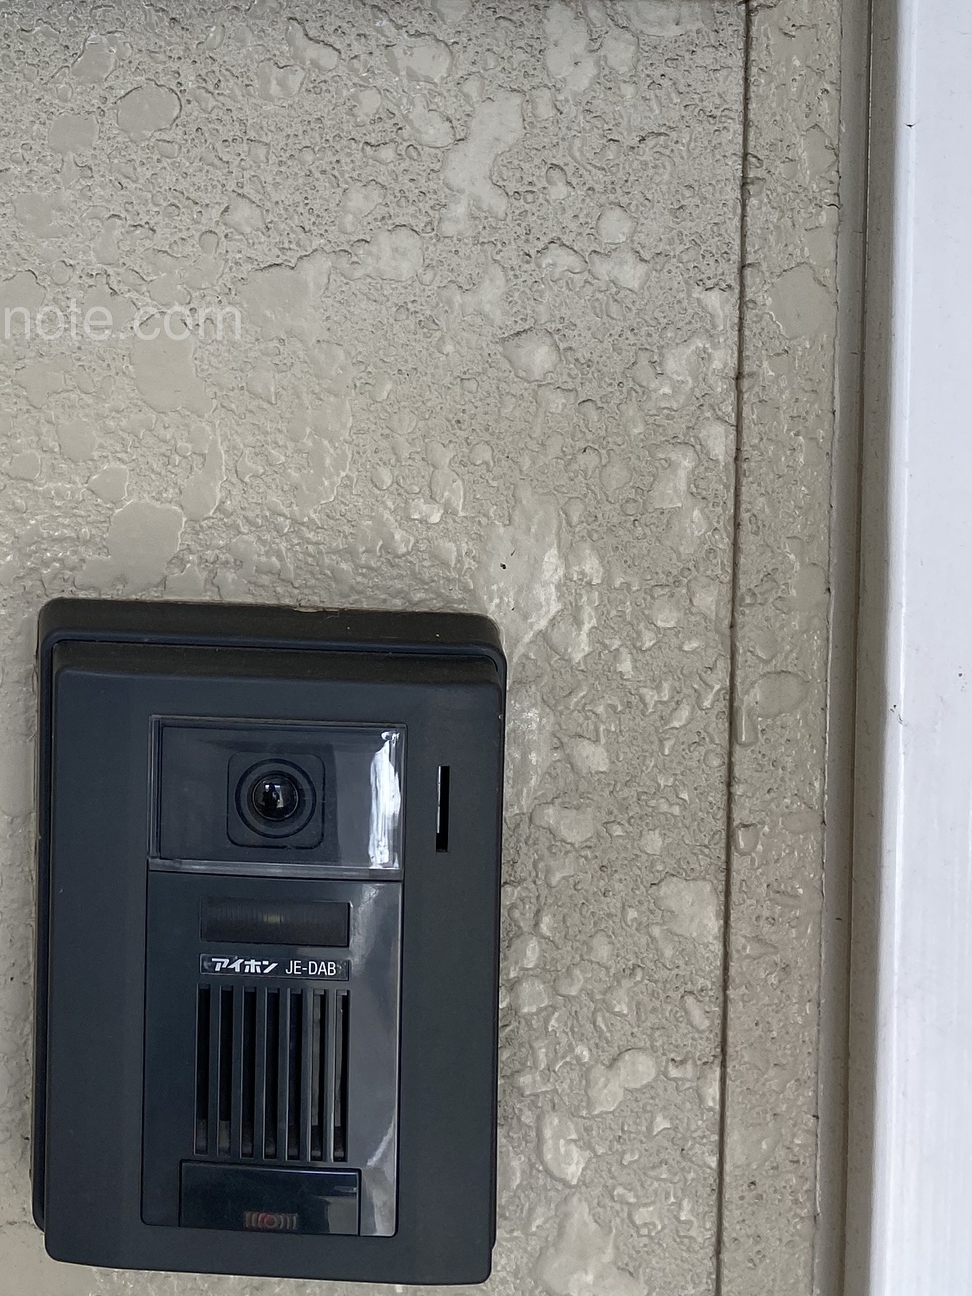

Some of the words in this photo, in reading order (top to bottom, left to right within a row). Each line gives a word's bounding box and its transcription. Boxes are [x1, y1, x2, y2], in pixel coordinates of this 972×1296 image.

[211, 957, 278, 973] アイホン
[285, 960, 336, 976] JE-DAB
